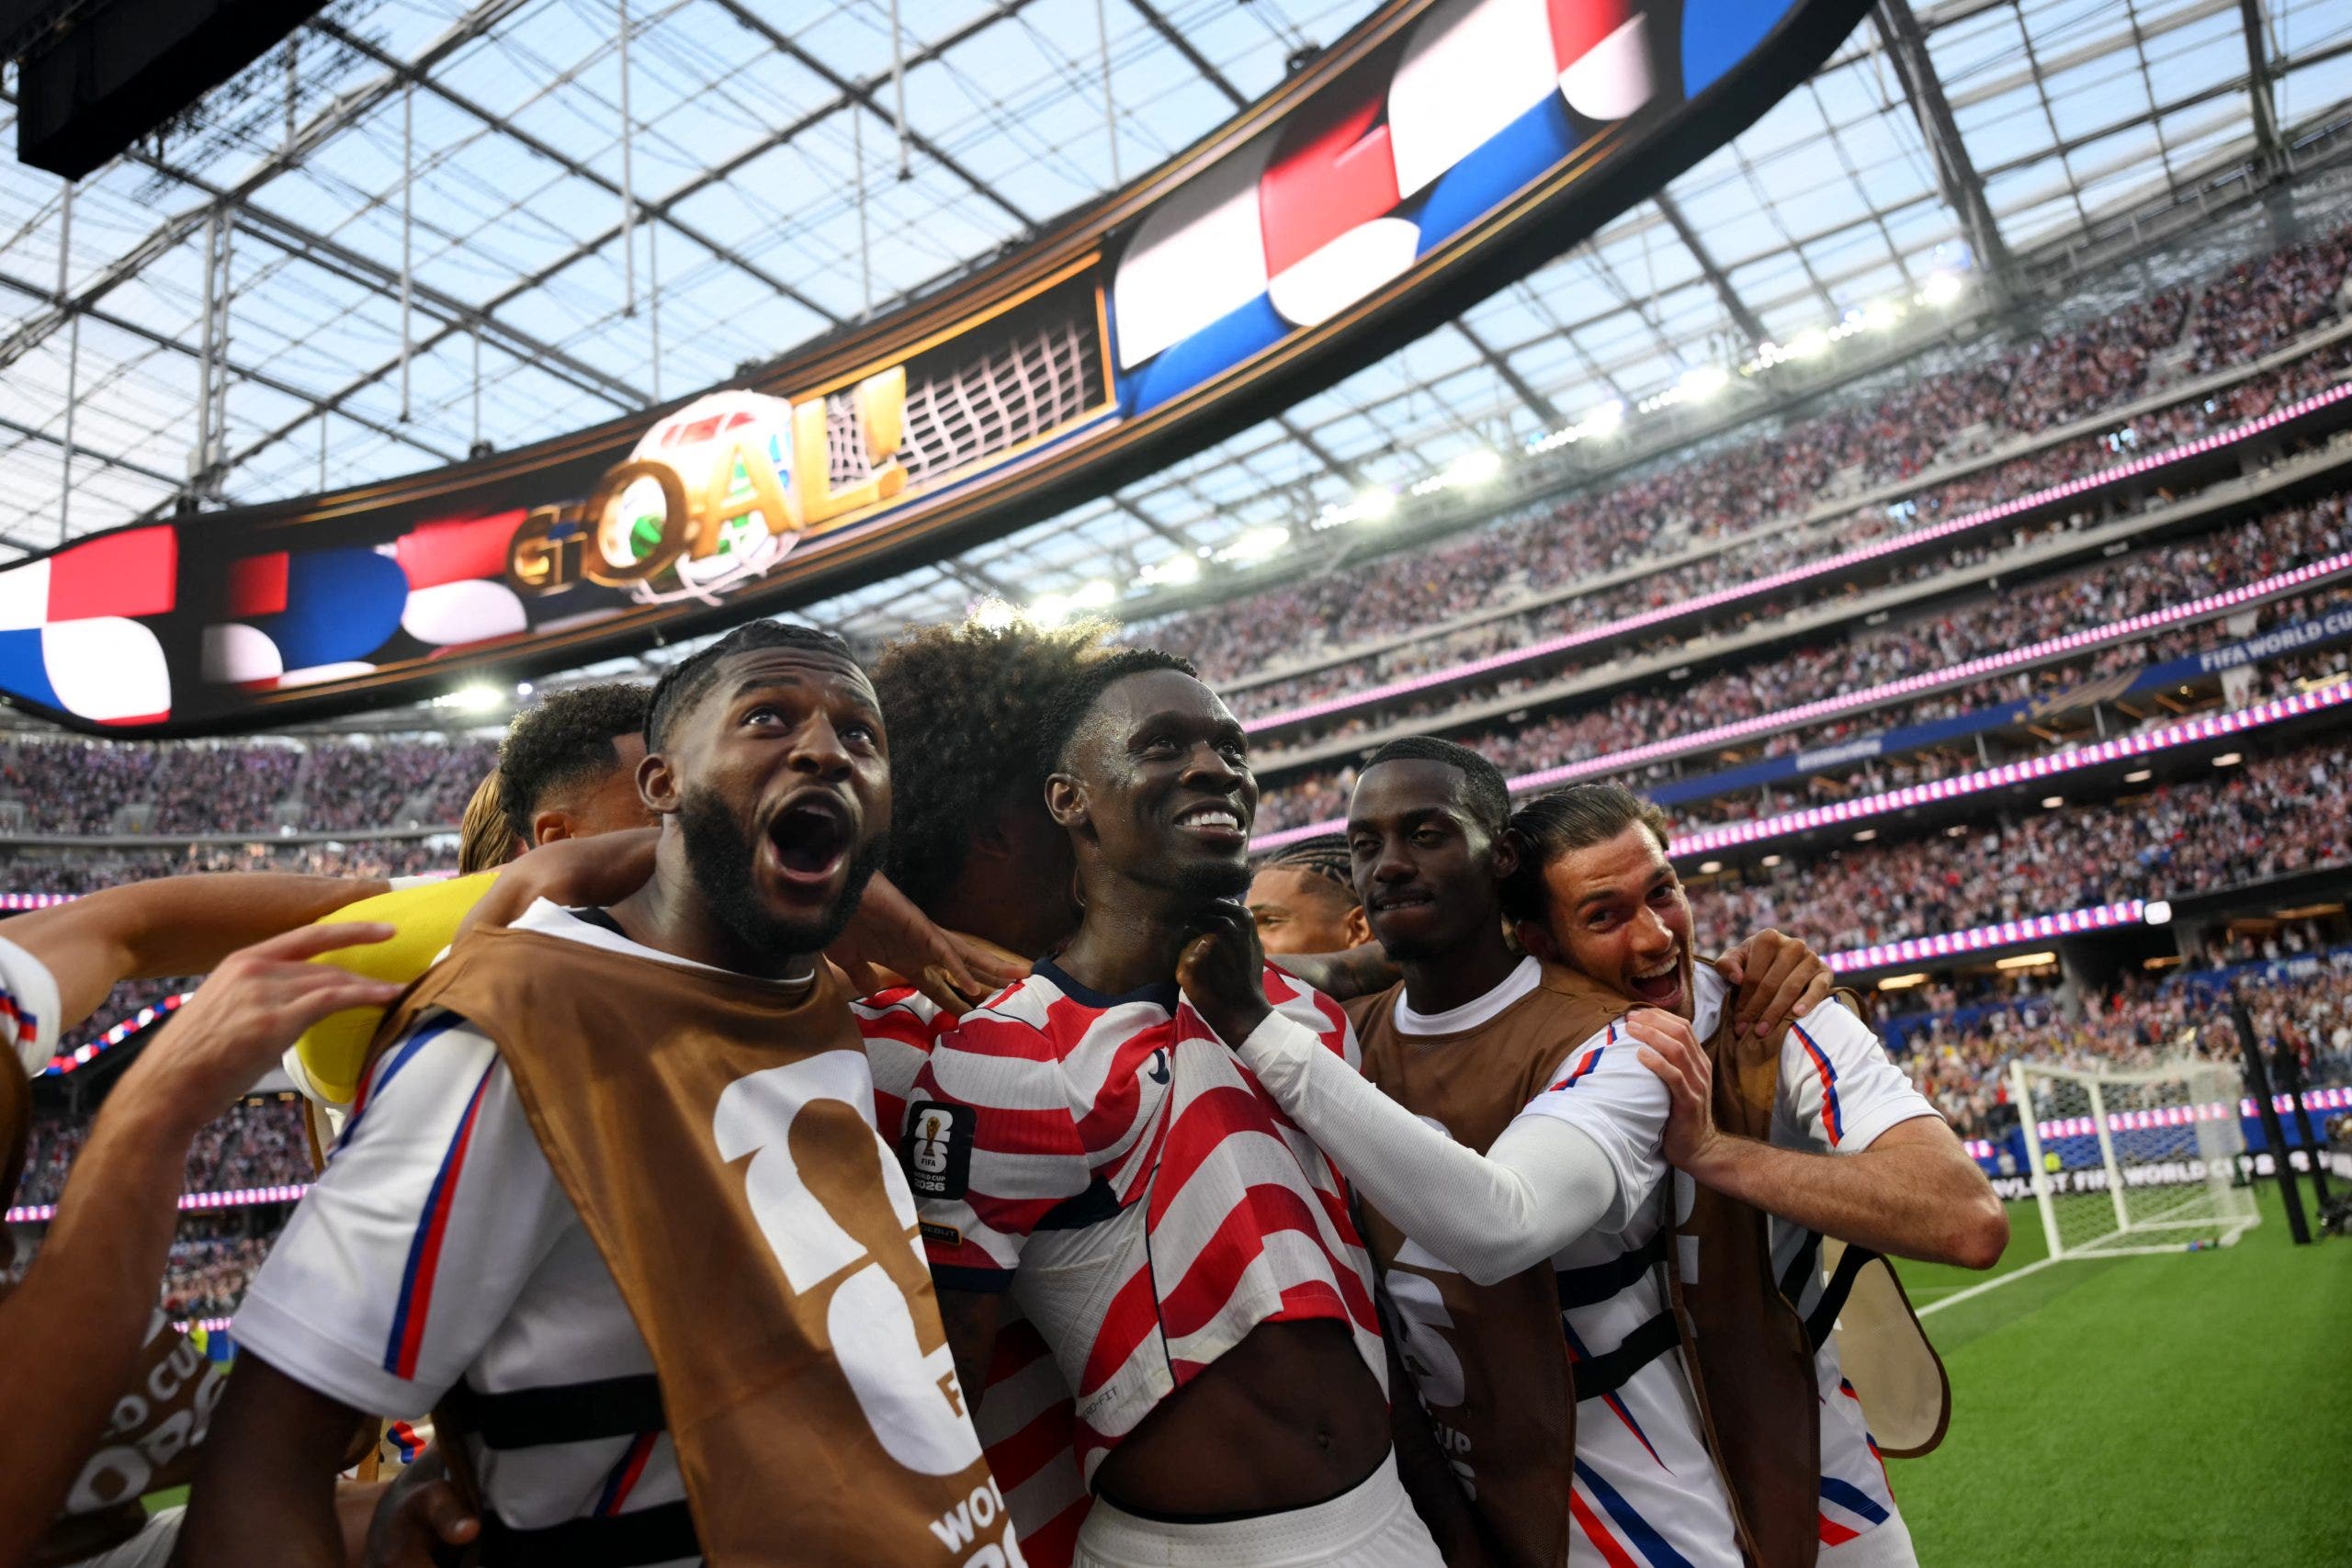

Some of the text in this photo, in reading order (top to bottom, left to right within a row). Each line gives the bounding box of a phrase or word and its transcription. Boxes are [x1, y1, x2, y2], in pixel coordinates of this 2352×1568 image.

[506, 365, 909, 597] GOAL!
[2200, 645, 2248, 672] FIFA
[2247, 620, 2324, 660] WORLD
[921, 1157, 936, 1167] FIFA
[2123, 1159, 2208, 1188] WORLD
[914, 1177, 946, 1192] 2026
[932, 1174, 946, 1182] CUP
[147, 1337, 200, 1402] CU
